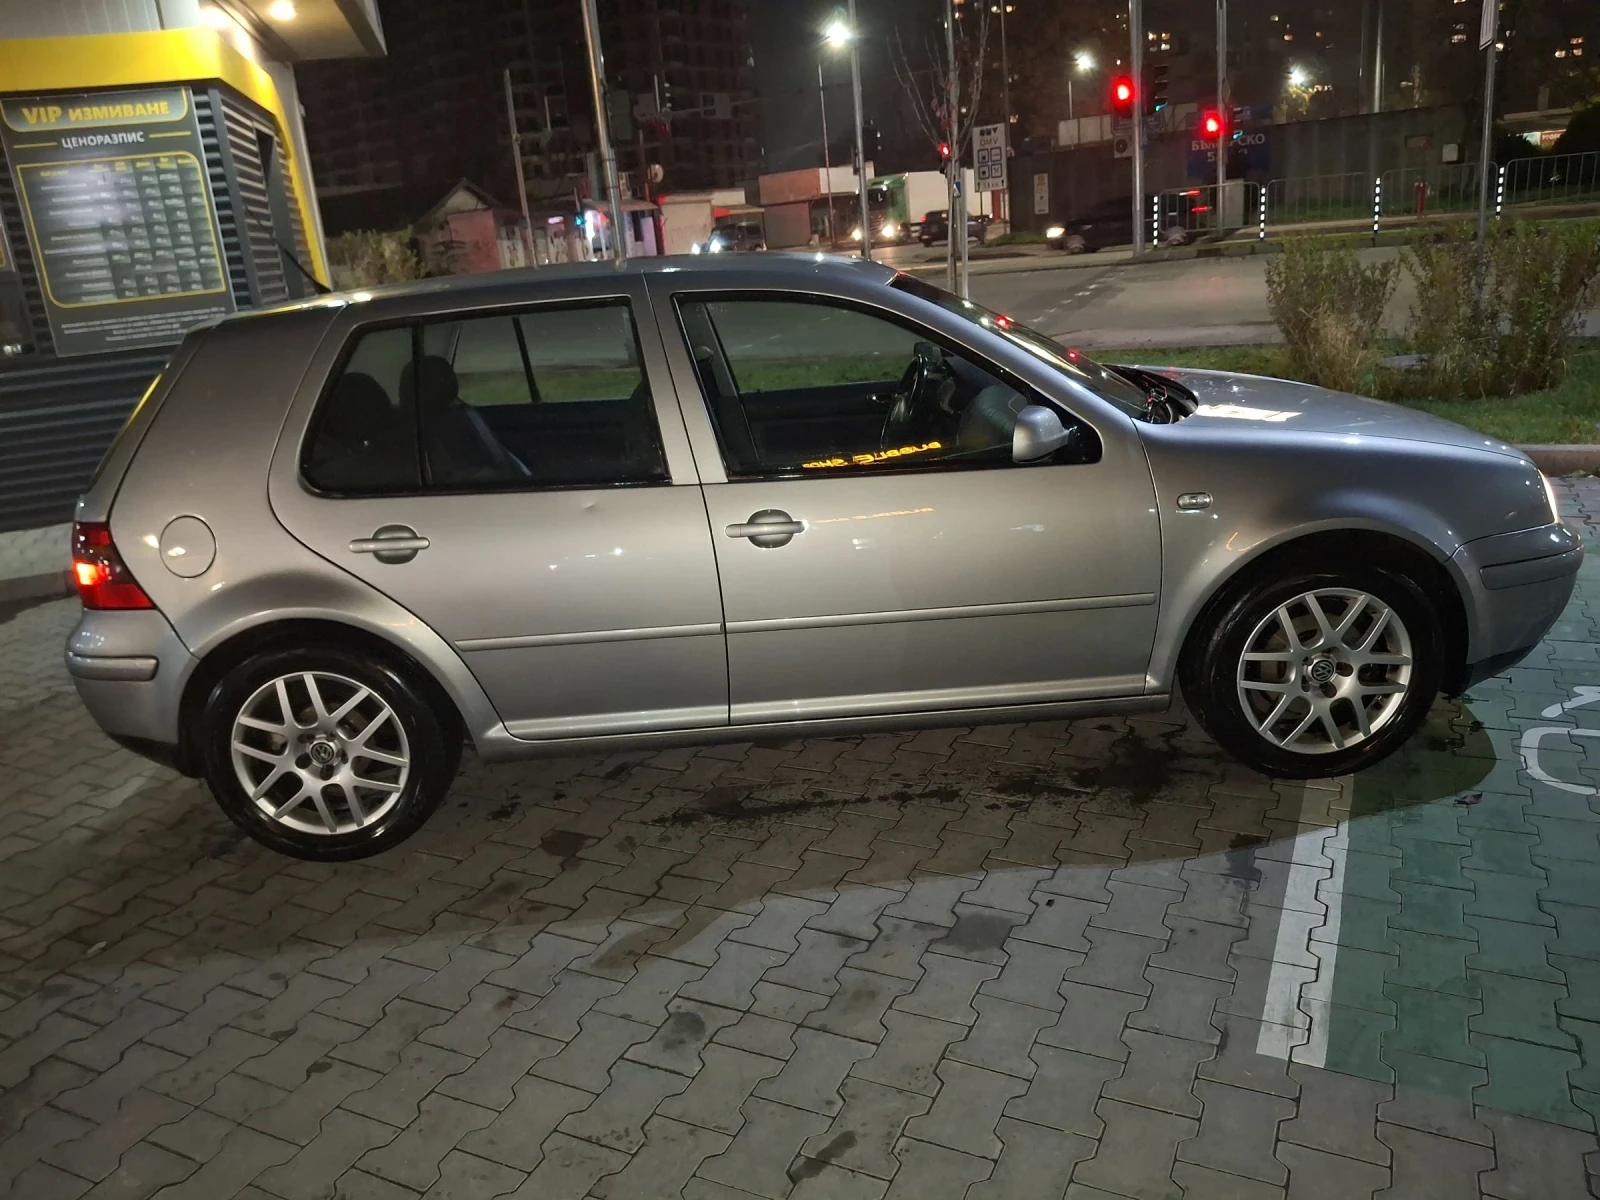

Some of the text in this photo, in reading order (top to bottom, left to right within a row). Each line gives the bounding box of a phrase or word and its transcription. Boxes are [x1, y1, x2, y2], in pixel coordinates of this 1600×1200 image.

[22, 101, 170, 125] VIP ИЗМИВАНЕ
[61, 131, 145, 149] ЦЕНОРАЗПИС
